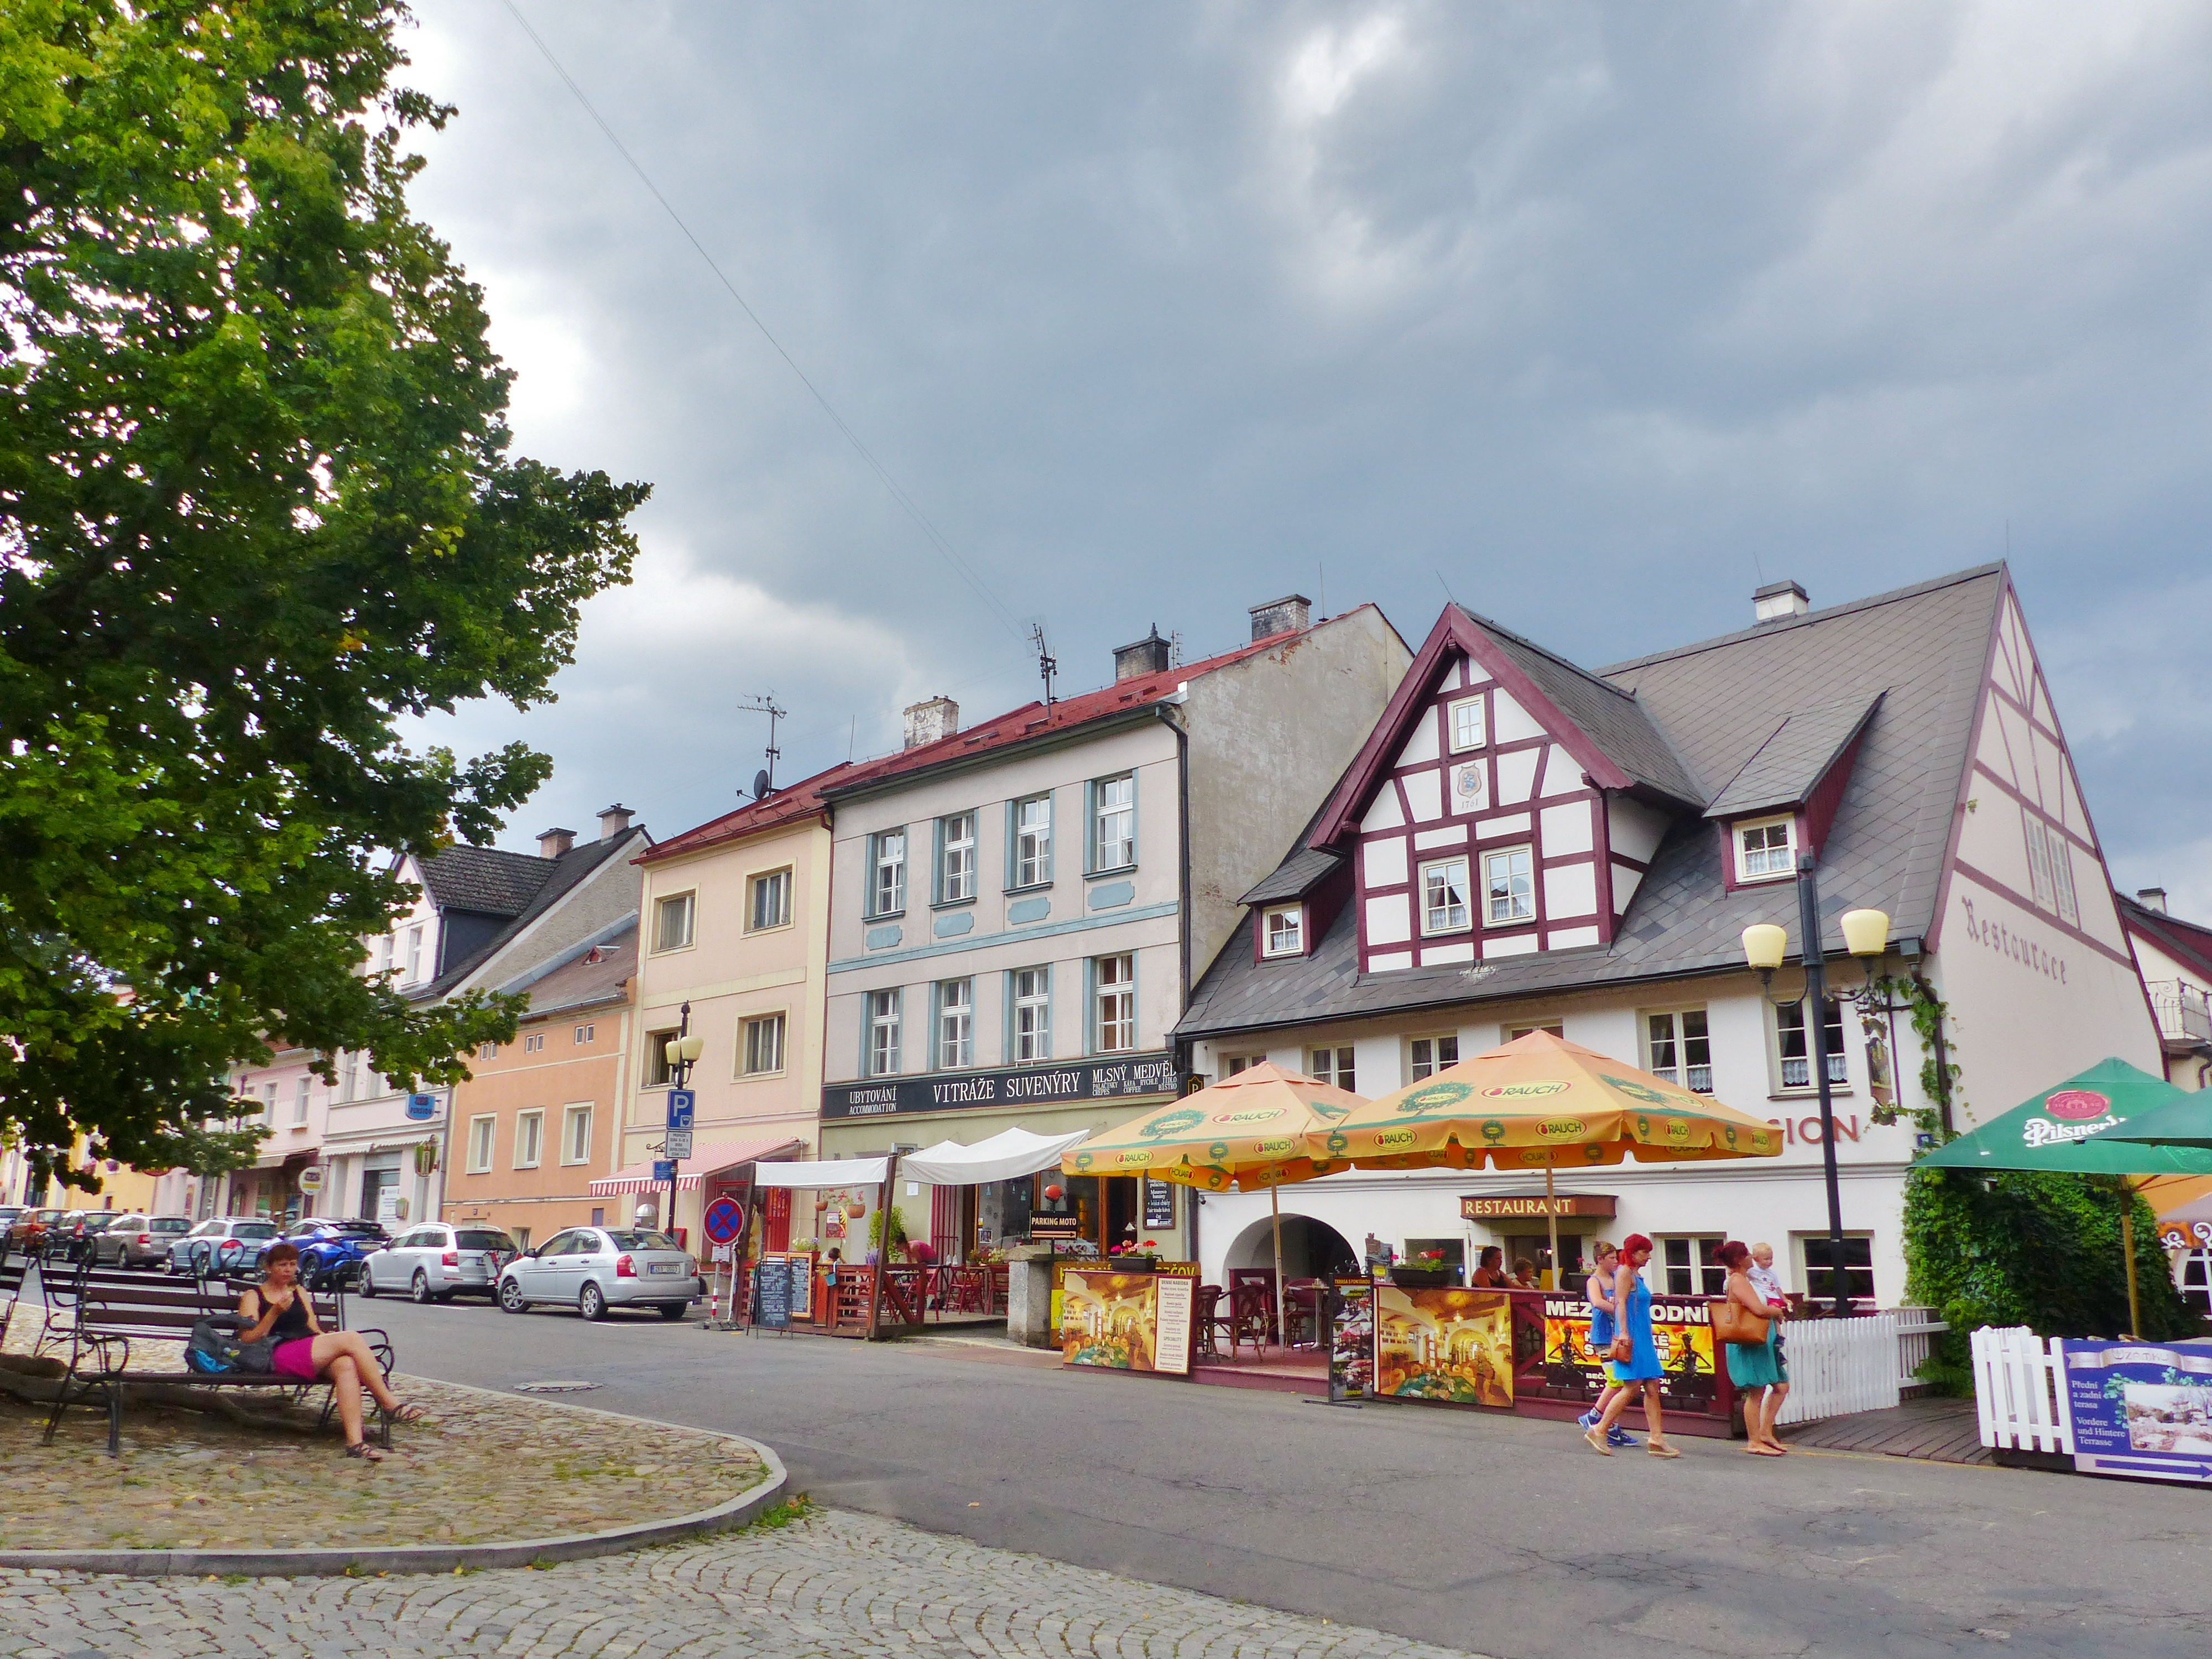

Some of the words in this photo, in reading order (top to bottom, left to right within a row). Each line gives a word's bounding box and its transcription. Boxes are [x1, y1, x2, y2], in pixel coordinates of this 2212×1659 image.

[1462, 799, 1478, 808] 1761
[1962, 895, 2067, 984] Restaurace
[1092, 1063, 1127, 1083] MLSNÝ
[933, 1077, 995, 1103] VITRÁŽE
[1006, 1071, 1081, 1098] SUVENÝRY
[1123, 1085, 1142, 1094] COFFEE
[1158, 1082, 1177, 1091] BISTRO
[1503, 1084, 1563, 1095] RAUCH
[849, 1085, 897, 1104] UBYTOVÁNÍ
[673, 1094, 690, 1117] P
[849, 1103, 897, 1115] ACCOMMODATION
[1230, 1110, 1280, 1121] RAUCH
[1548, 1123, 1582, 1134] RAUCH
[1671, 1125, 1688, 1136] RAUCH
[2022, 1118, 2109, 1147] Pilsner
[1384, 1133, 1412, 1144] RAUCH
[1264, 1141, 1291, 1152] RAUCH
[1125, 1153, 1150, 1162] RAUCH
[1031, 1217, 1056, 1225] PARKING
[1059, 1218, 1077, 1226] MOTO
[2072, 1380, 2098, 1390] Přední
[2076, 1416, 2109, 1427] Vordere
[2095, 1428, 2126, 1438] Hintere
[2078, 1436, 2113, 1447] Terrasse
